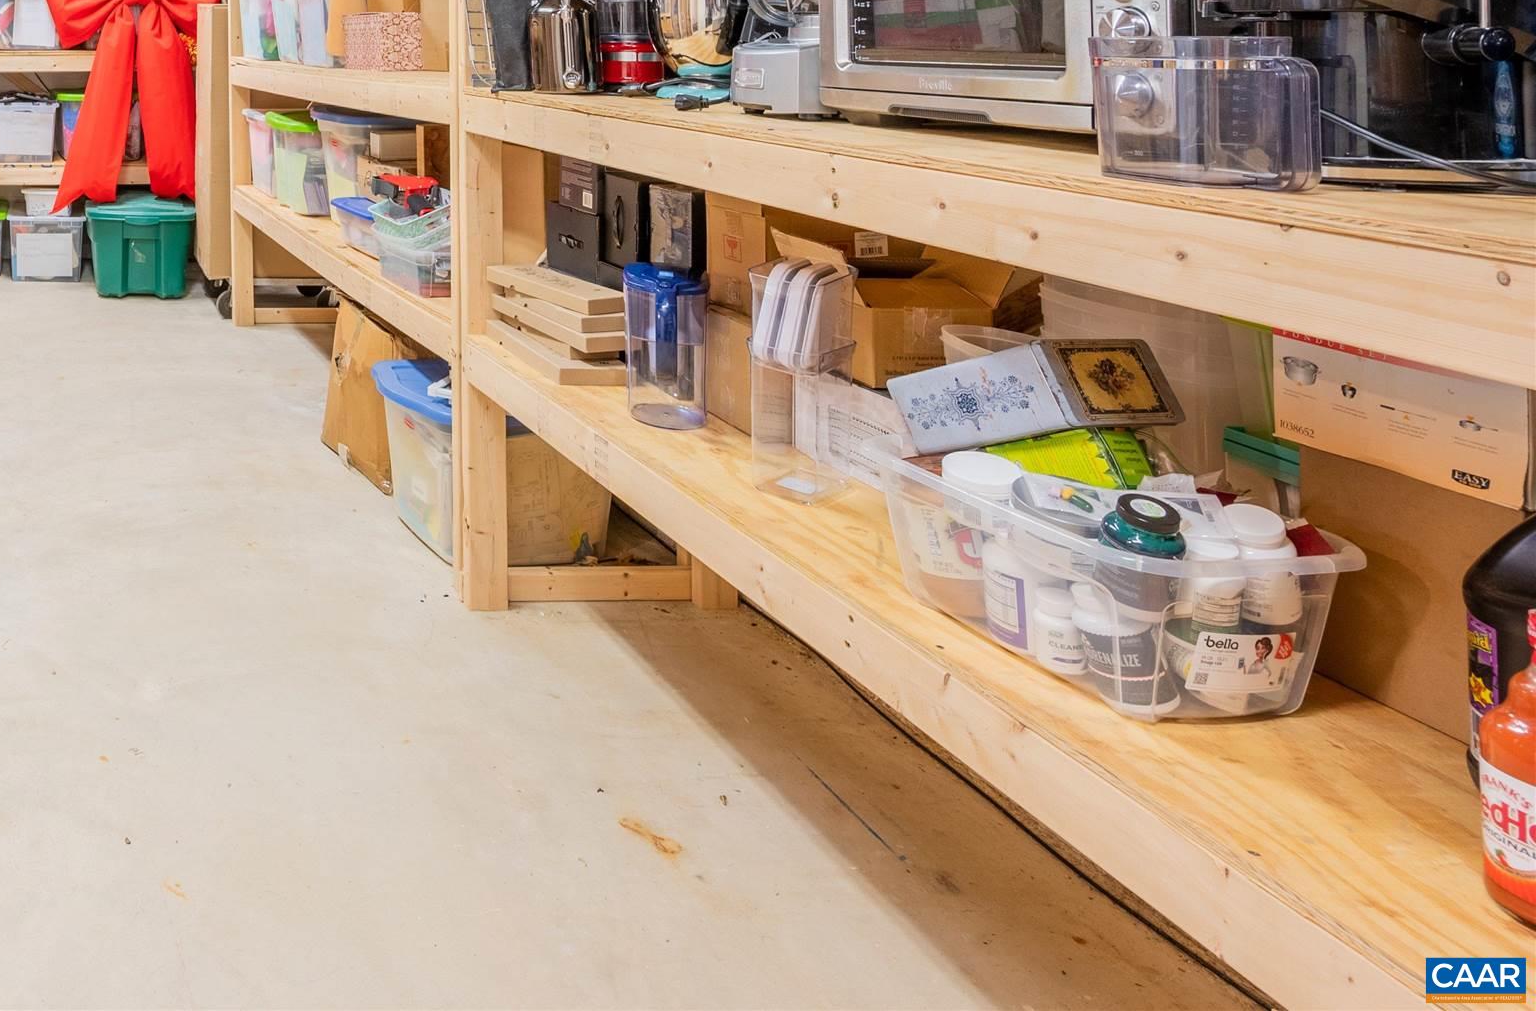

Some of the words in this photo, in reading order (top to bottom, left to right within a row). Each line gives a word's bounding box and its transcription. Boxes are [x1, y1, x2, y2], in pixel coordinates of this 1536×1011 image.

[1280, 419, 1315, 439] 1038652
[1453, 470, 1488, 487] EASY
[1205, 636, 1239, 650] bella
[1482, 774, 1532, 809] RANK'S
